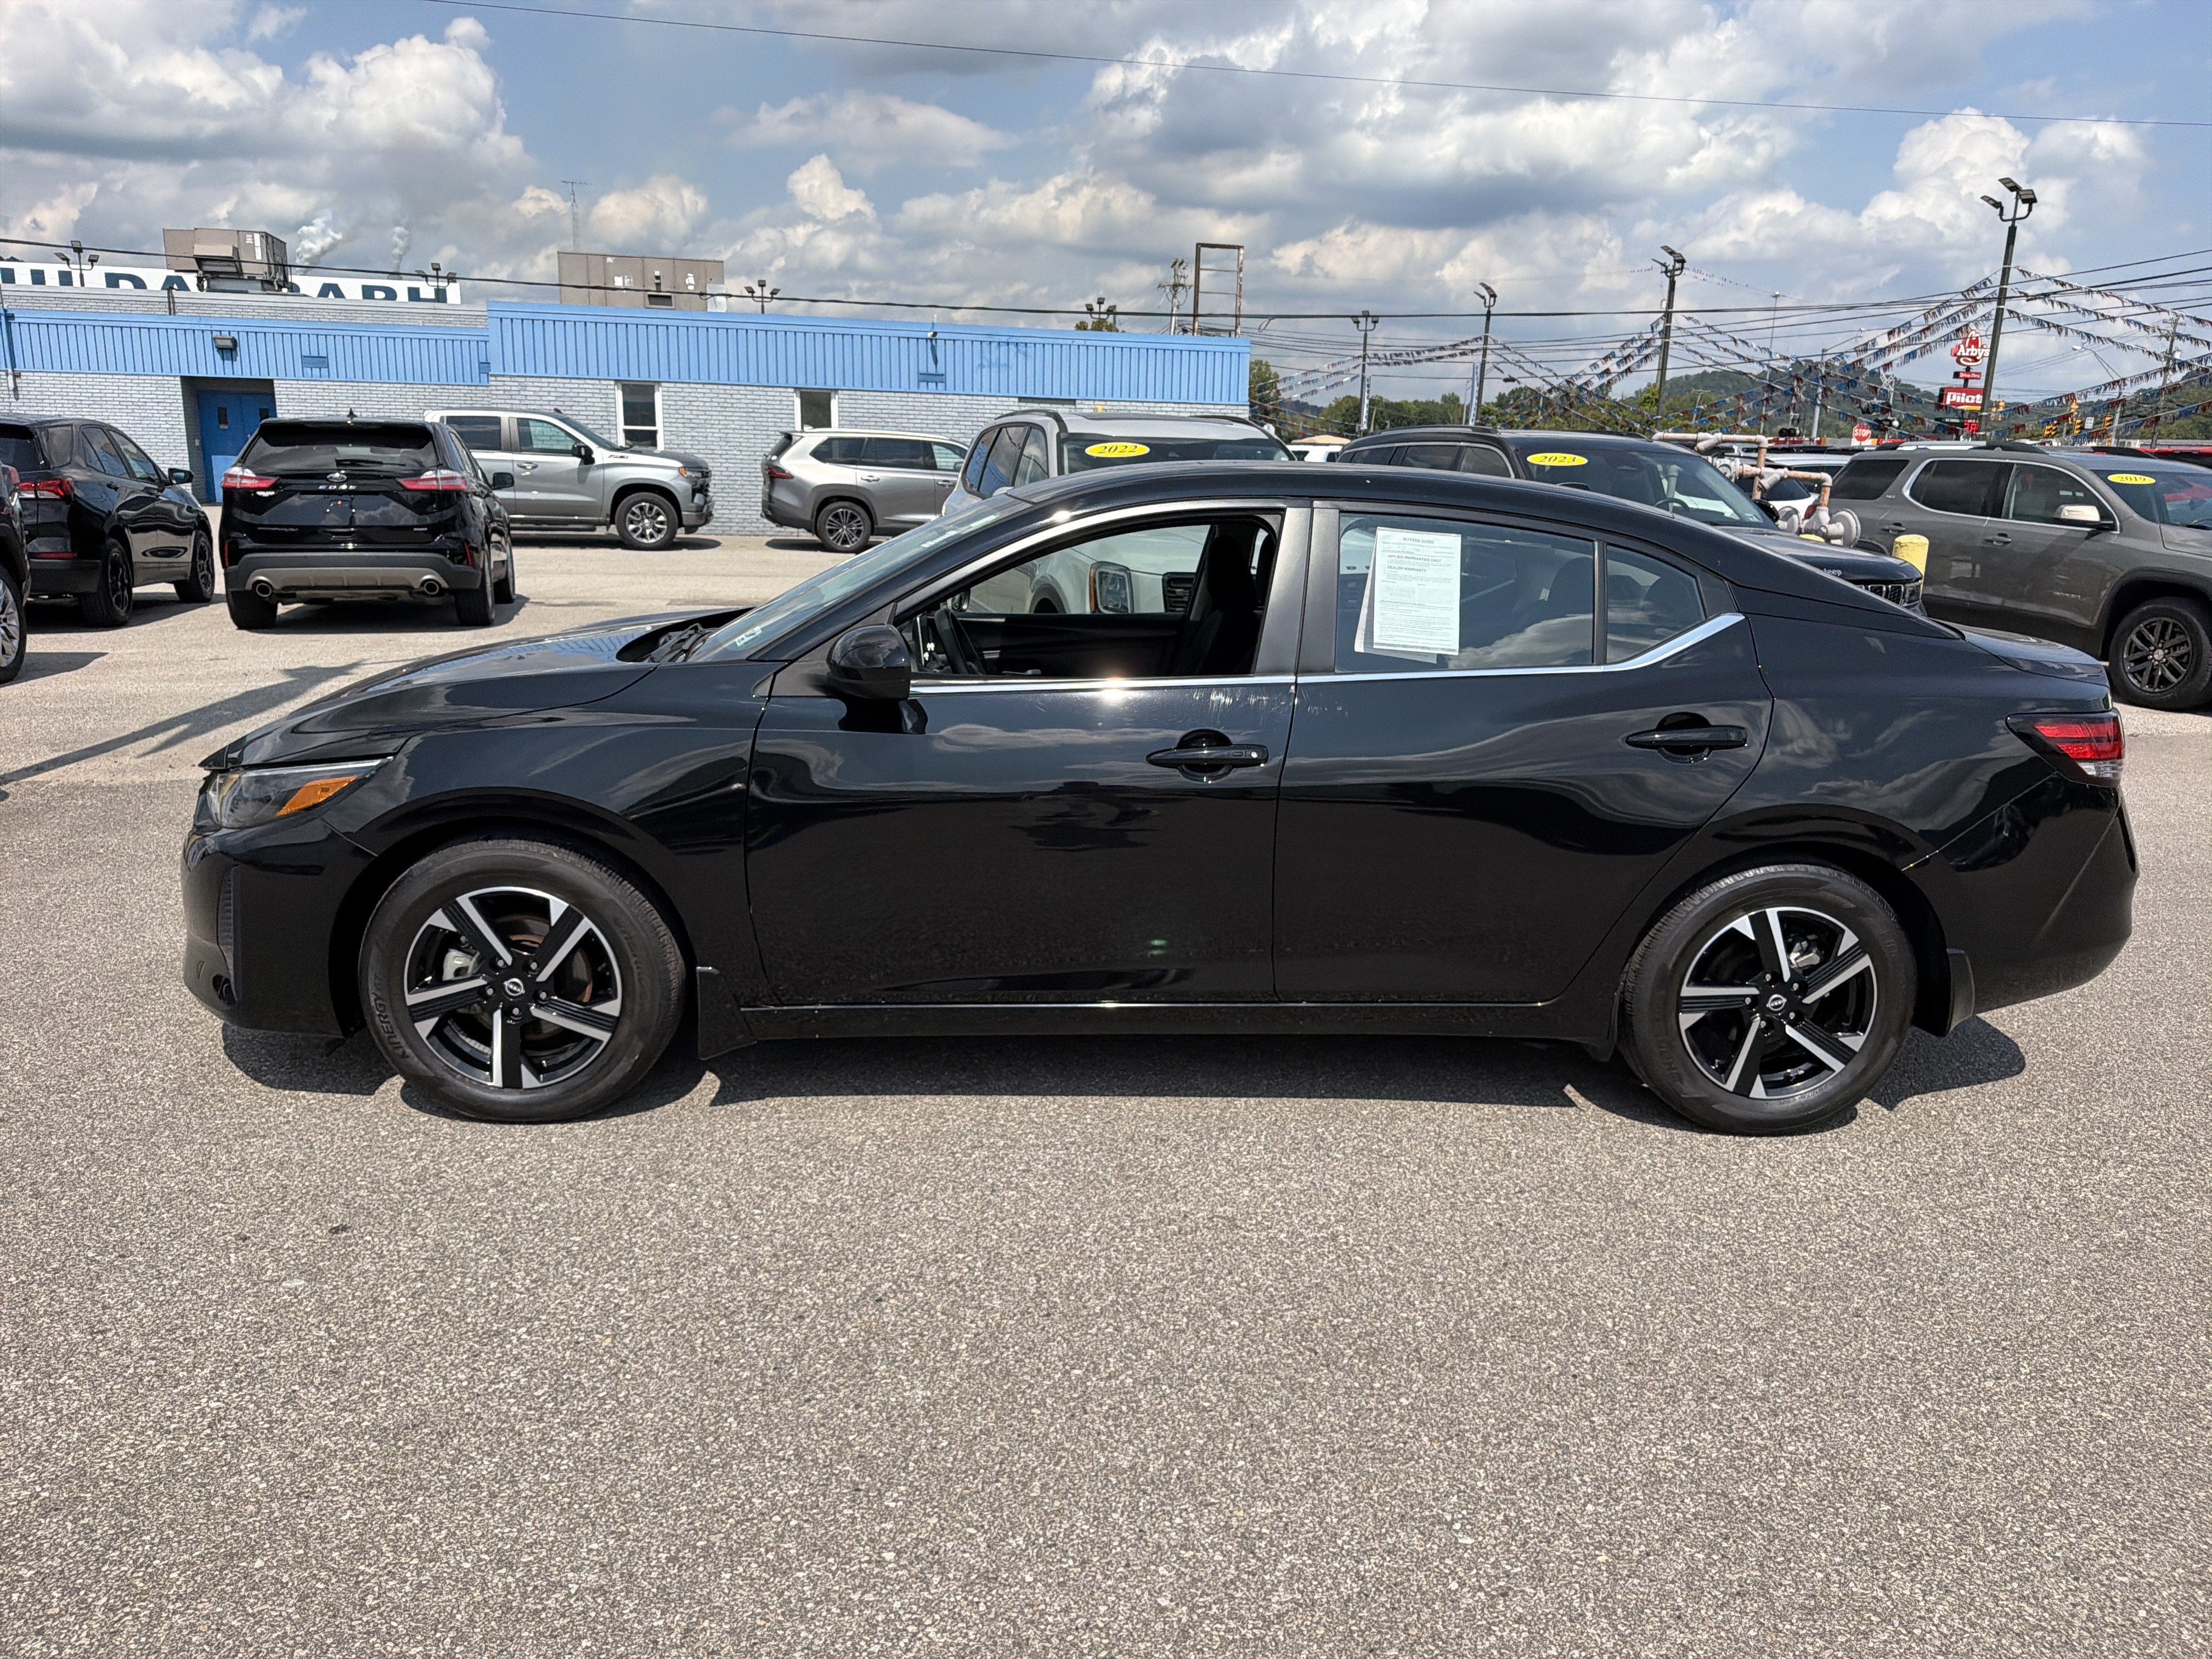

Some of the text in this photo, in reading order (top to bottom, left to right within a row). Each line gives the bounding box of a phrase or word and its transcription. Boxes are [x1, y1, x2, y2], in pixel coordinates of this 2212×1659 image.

[1946, 392, 1983, 405] Pilot
[1854, 428, 1871, 437] STOP
[1098, 445, 1138, 454] 2022
